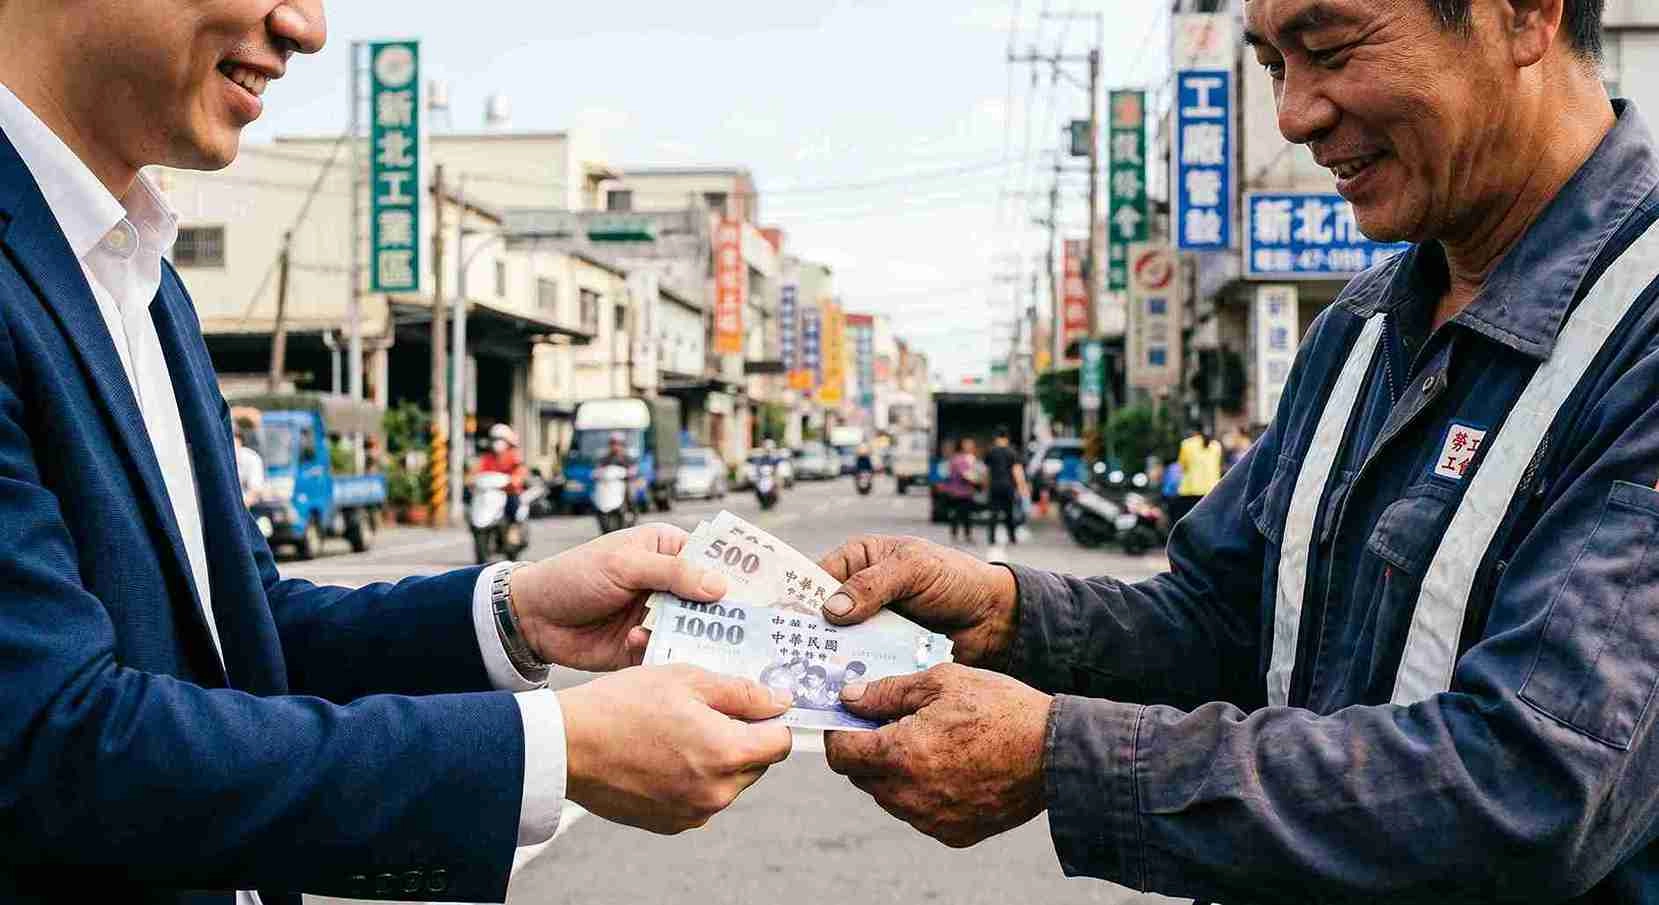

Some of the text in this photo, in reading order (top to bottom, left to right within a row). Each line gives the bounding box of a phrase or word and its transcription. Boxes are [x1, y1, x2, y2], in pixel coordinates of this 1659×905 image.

[377, 90, 415, 288] 新北工業區
[704, 538, 760, 574] 500
[672, 615, 745, 645] 1000
[771, 631, 838, 652] 中華民國
